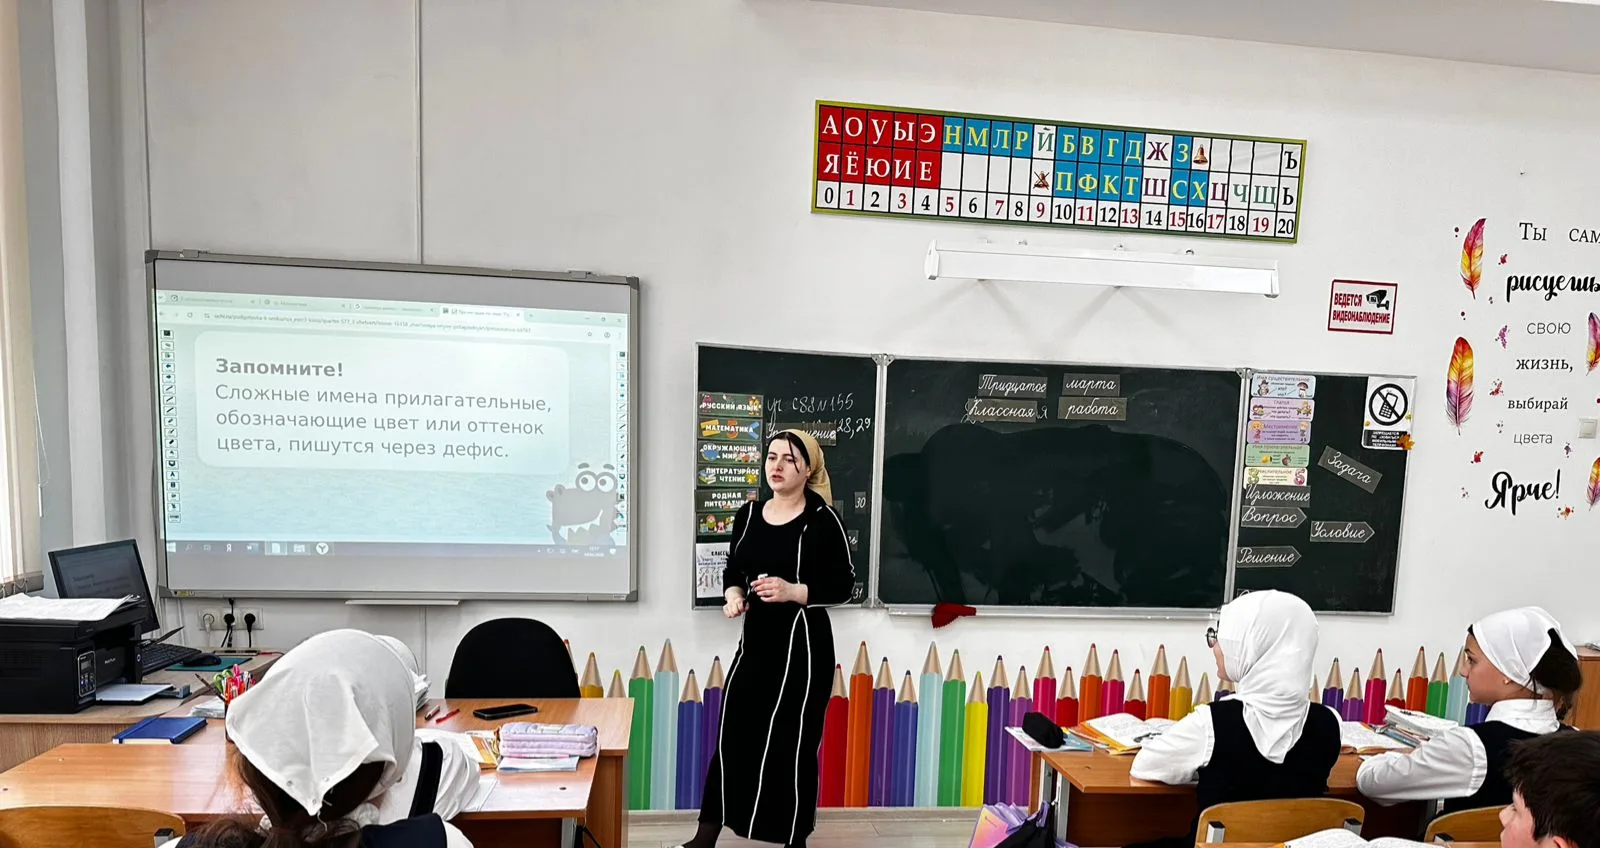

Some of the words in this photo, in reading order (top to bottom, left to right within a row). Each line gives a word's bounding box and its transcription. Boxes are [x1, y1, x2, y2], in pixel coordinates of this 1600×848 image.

[822, 115, 839, 135] А
[845, 117, 863, 137] О
[871, 119, 888, 144] У
[894, 121, 915, 141] Ы
[920, 123, 936, 143] Э
[944, 125, 962, 145] Н
[967, 127, 988, 148] М
[993, 129, 1009, 149] Л
[1015, 131, 1029, 150] Р
[1037, 127, 1054, 152] Й
[1063, 134, 1075, 154] Б
[1081, 136, 1094, 155] В
[1107, 138, 1119, 157] Г
[1125, 140, 1142, 164] Д
[1147, 142, 1170, 161] Ж
[1176, 144, 1189, 163] З
[1284, 151, 1297, 170] Ъ
[823, 154, 840, 174] Я
[846, 151, 859, 175] Ё
[865, 158, 890, 178] Ю
[894, 159, 912, 180] И
[920, 161, 932, 181] Е
[1056, 172, 1073, 191] П
[1078, 173, 1098, 193] Ф
[1103, 175, 1119, 195] К
[1124, 177, 1139, 196] Т
[1143, 177, 1167, 197] Ш
[1172, 180, 1188, 199] С
[1192, 181, 1206, 200] Х
[1210, 182, 1228, 207] Ц
[1233, 184, 1248, 203] Ч
[1253, 185, 1277, 209] Щ
[1282, 187, 1294, 206] Ь
[824, 187, 834, 204] 0
[846, 189, 855, 206] 1
[870, 191, 880, 208] 2
[897, 193, 907, 209] 3
[921, 195, 931, 211] 4
[945, 196, 954, 212] 5
[968, 197, 978, 214] 6
[995, 199, 1005, 216] 7
[1014, 200, 1023, 217] 8
[1036, 202, 1045, 218] 9
[1054, 204, 1073, 220] 10
[1077, 206, 1094, 222] 11
[1100, 207, 1117, 224] 12
[1121, 208, 1138, 224] 13
[1145, 209, 1162, 226] 14
[1169, 211, 1186, 227] 15
[1187, 212, 1204, 229] 16
[1207, 214, 1225, 229] 17
[1229, 215, 1245, 232] 18
[1253, 217, 1270, 233] 19
[1277, 219, 1294, 235] 20
[1334, 293, 1362, 308] ВЕДЕТСЯ
[1333, 310, 1390, 325] ВИДЕОНАБЛЮДЕНИЕ
[216, 357, 343, 377] Запомните!
[1516, 359, 1573, 372] жизнь,
[978, 374, 1046, 396] Тридцатое
[1066, 378, 1116, 396] марта
[215, 384, 310, 402] Сложные
[317, 391, 378, 404] имена
[385, 392, 551, 413] прилагательные,
[702, 402, 735, 410] РУССКИЙ
[1508, 397, 1568, 412] выбирай
[969, 398, 1035, 418] Классная
[1065, 398, 1119, 420] работа
[216, 409, 367, 430] обозначающие
[374, 417, 419, 431] цвет
[426, 418, 461, 432] или
[467, 420, 544, 435] оттенок
[705, 425, 754, 433] МАТЕМАТИКА
[217, 437, 282, 452] цвета,
[289, 439, 374, 456] пишутся
[381, 442, 436, 457] через
[443, 442, 509, 460] дефис.
[703, 444, 757, 452] ОКРУЖАЮЩИЙ
[1513, 433, 1553, 445] цвета
[1328, 452, 1371, 484] Задача
[855, 497, 867, 508] 30
[1245, 484, 1311, 505] Изложение
[1485, 469, 1560, 516] Ярче!
[1242, 507, 1298, 528] Вопрос
[1311, 522, 1365, 538] Условие
[1237, 547, 1296, 563] Решение
